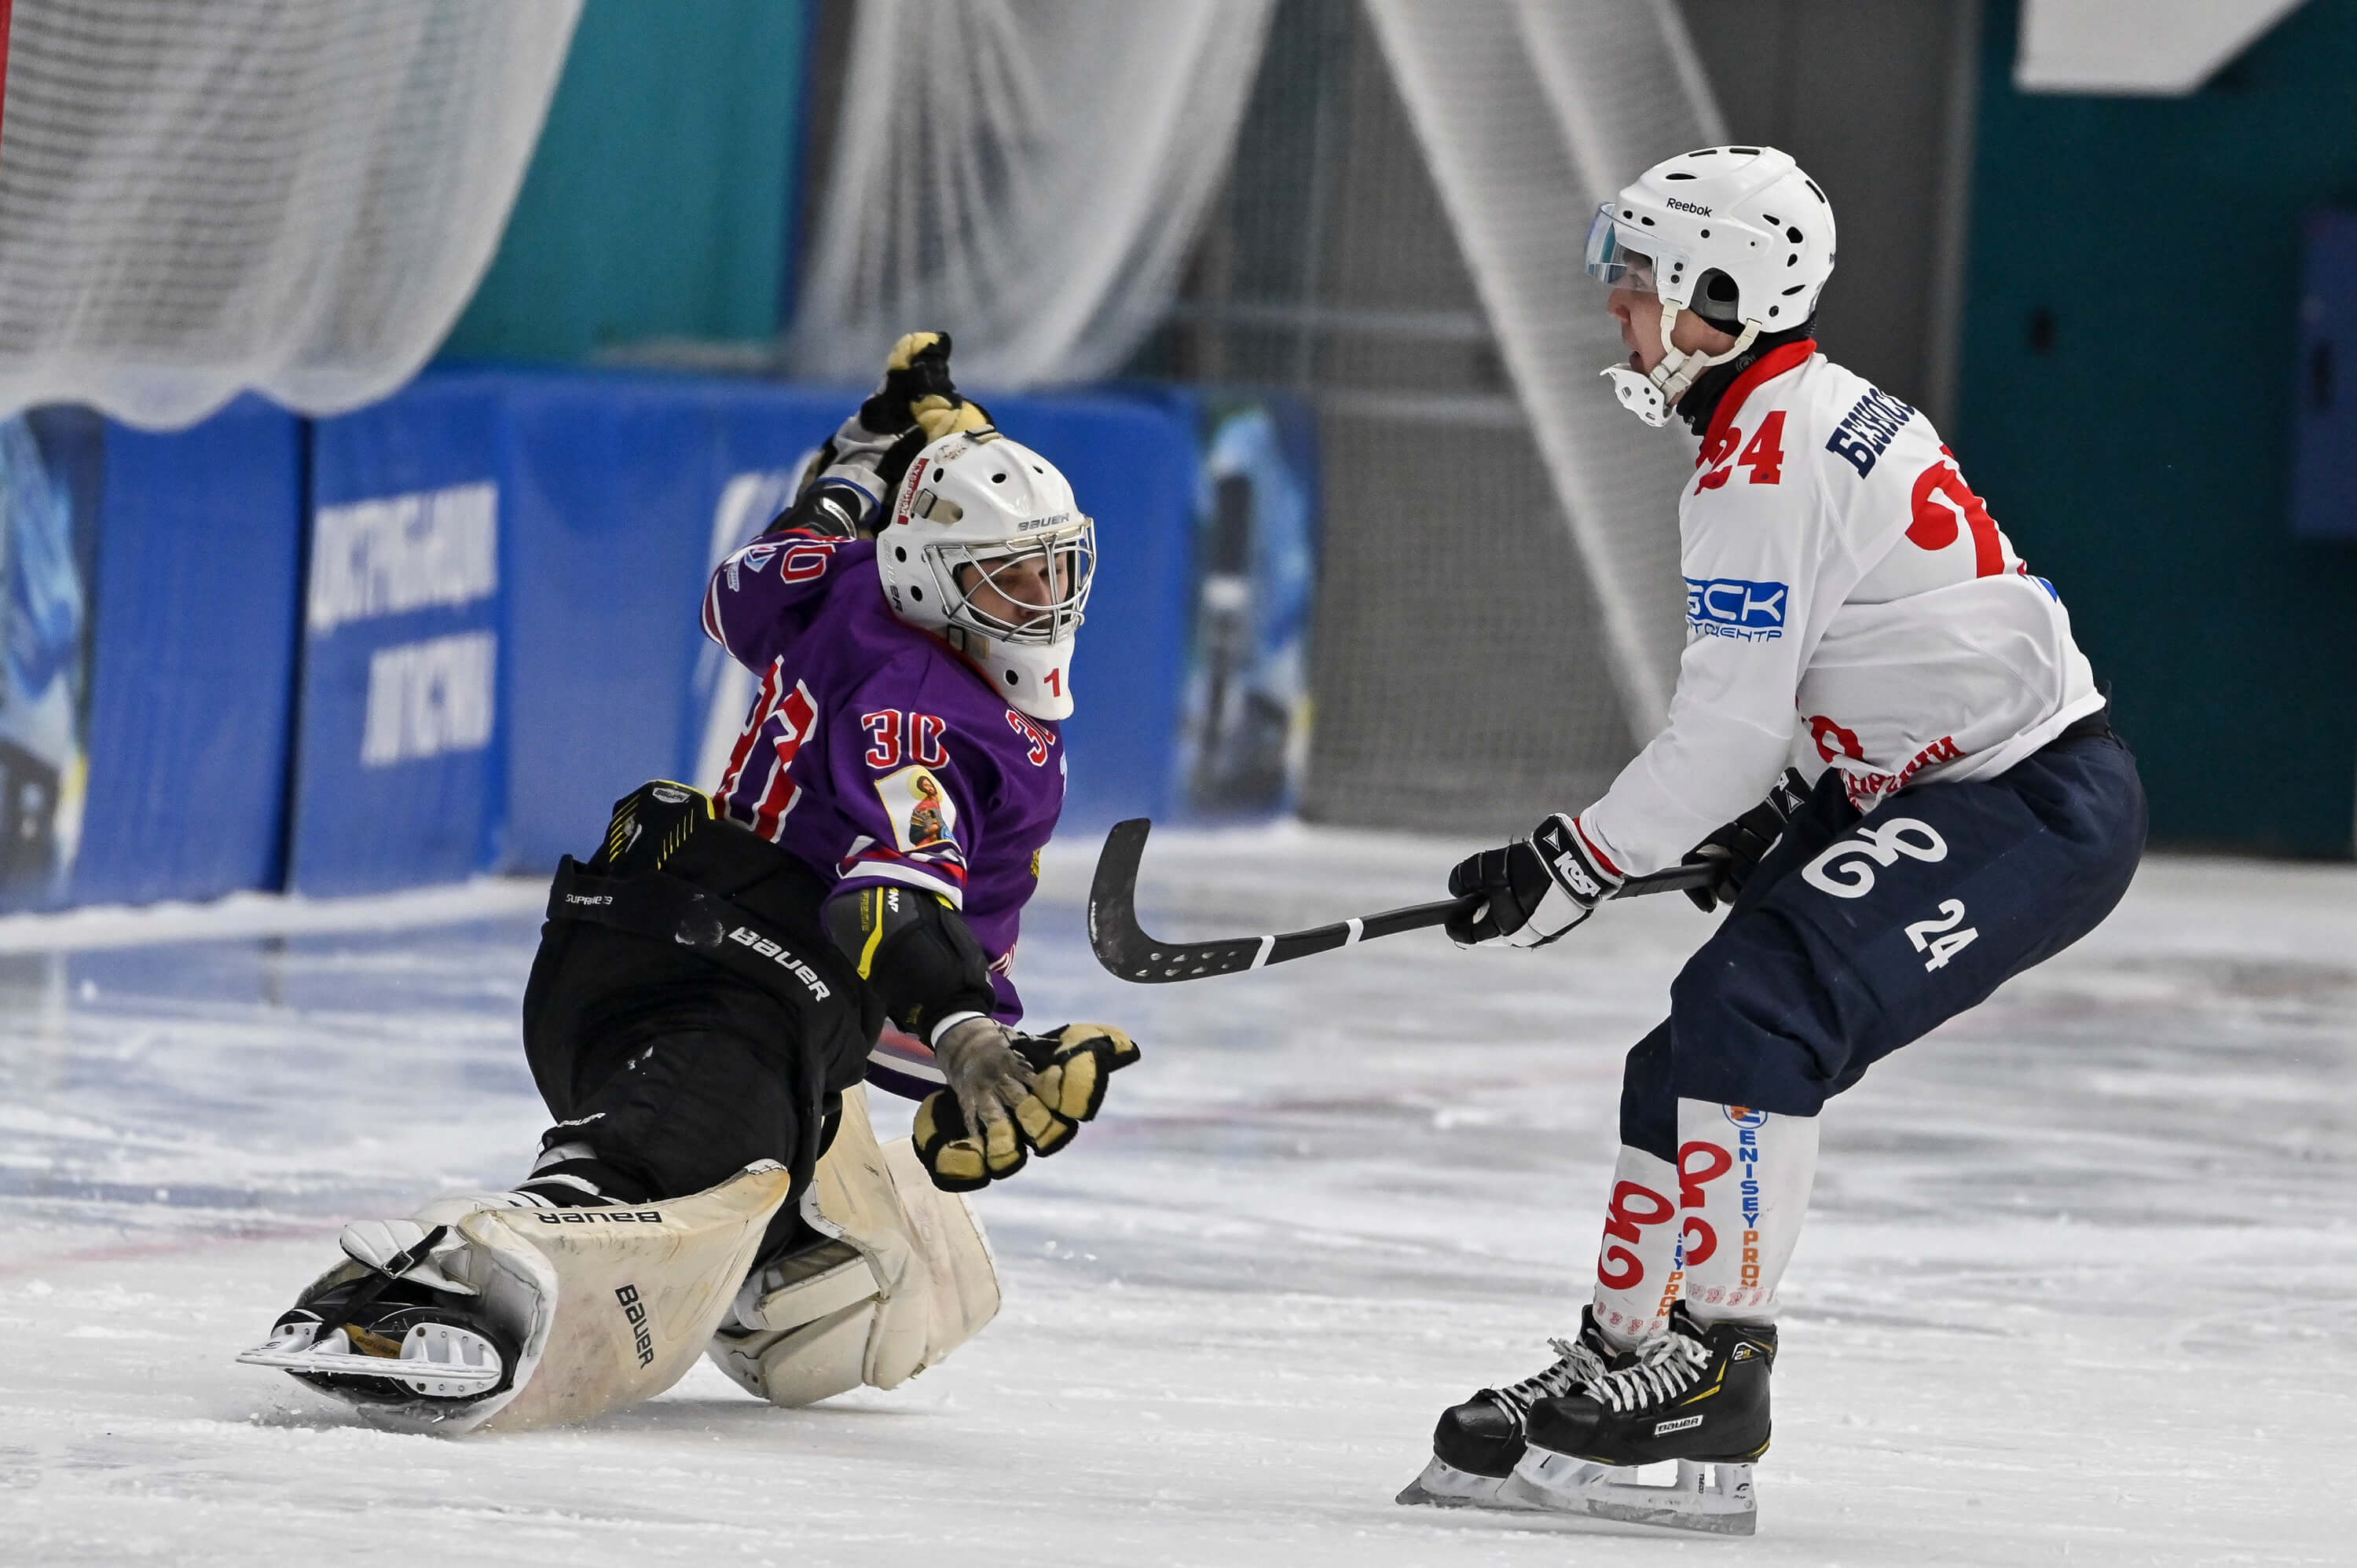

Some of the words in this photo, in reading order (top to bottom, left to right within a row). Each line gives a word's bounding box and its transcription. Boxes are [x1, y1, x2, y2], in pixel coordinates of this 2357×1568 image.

[1666, 197, 1713, 218] Reebok
[1694, 410, 1787, 496] 24
[1018, 513, 1069, 532] BAUER
[1043, 668, 1061, 698] 1
[861, 709, 949, 770] 30
[1904, 898, 1979, 973] 24
[728, 926, 830, 1002] BAUER
[533, 1211, 663, 1224] BAUER
[614, 1284, 654, 1369] BAUER
[1658, 1417, 1699, 1434] BAUER
